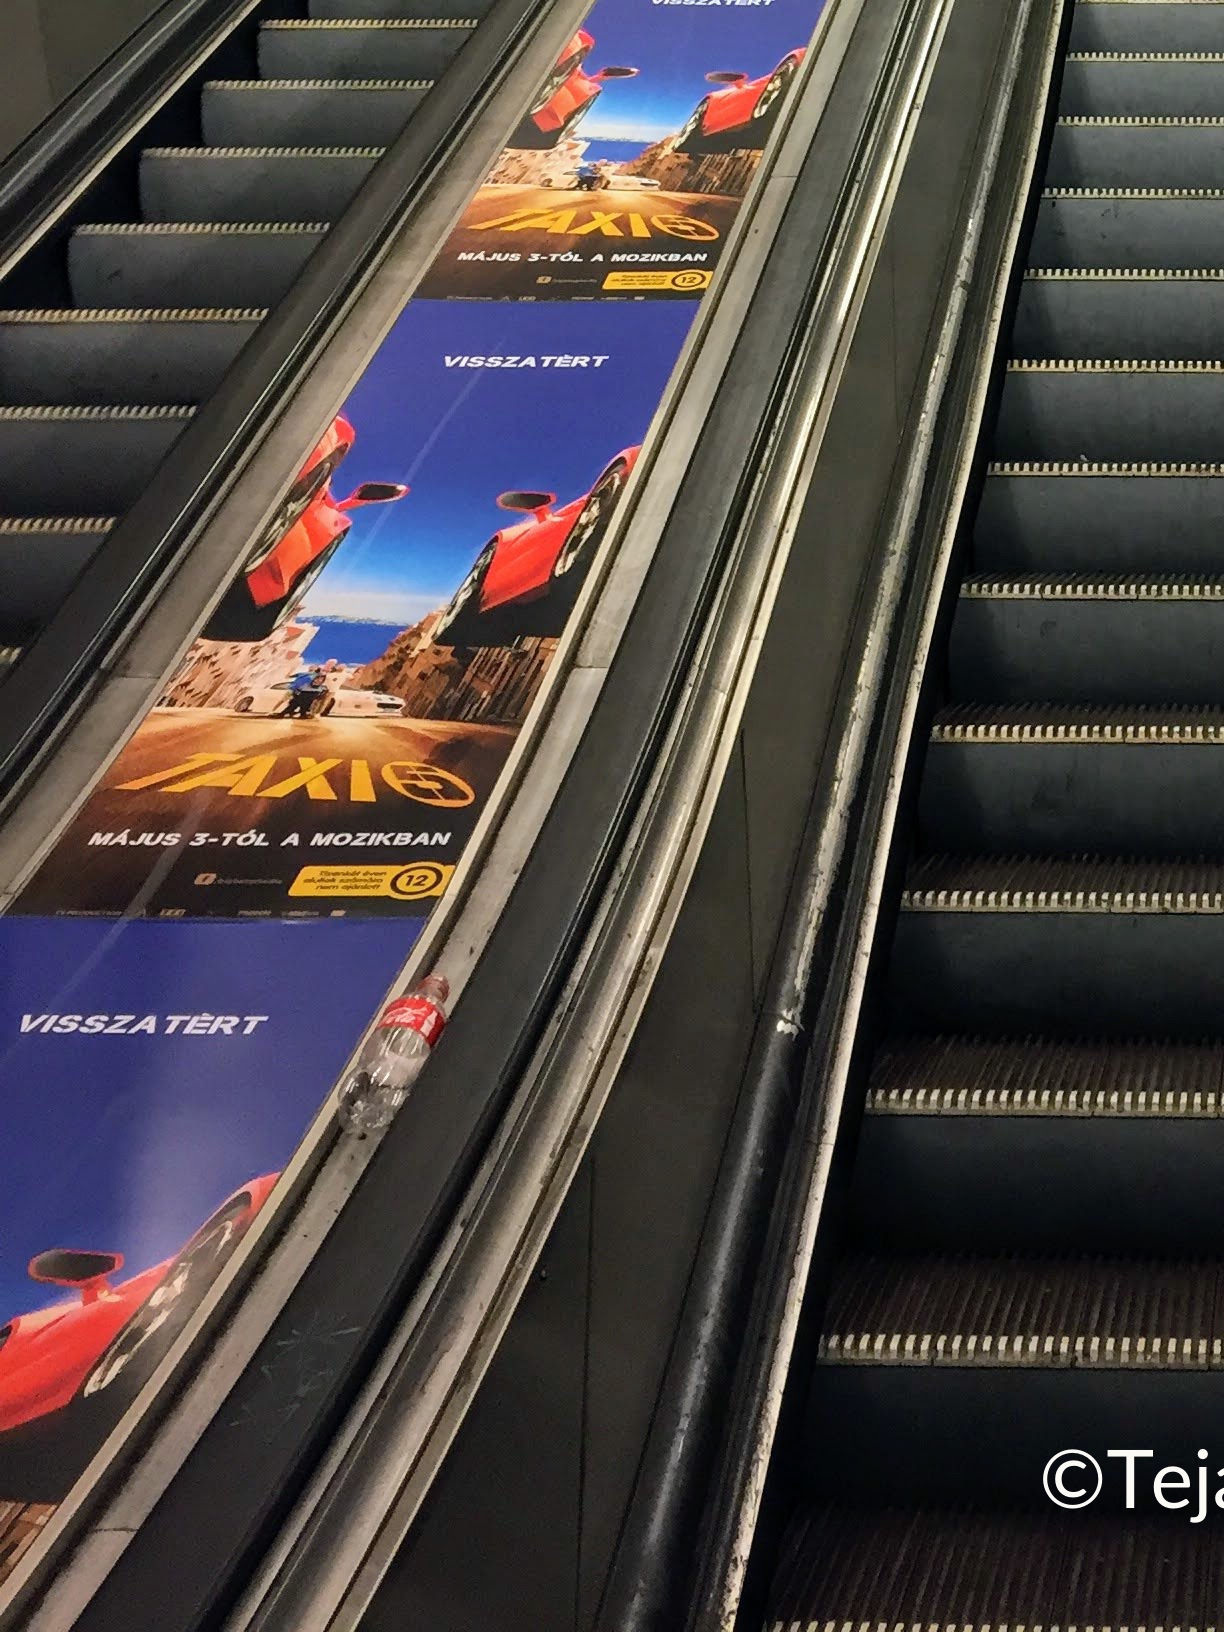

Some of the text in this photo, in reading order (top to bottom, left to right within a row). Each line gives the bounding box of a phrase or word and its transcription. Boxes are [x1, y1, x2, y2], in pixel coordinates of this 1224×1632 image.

[467, 208, 652, 238] TAXI
[457, 250, 708, 262] MÁJUS 3-TÓL A MOZIKBAN
[681, 276, 697, 284] 12
[444, 354, 610, 369] VISSZATÉRT
[114, 752, 377, 803] TAXI
[87, 828, 452, 848] MÁJUS 3-TÓL A MOZIKBAN
[404, 874, 428, 887] 12
[18, 1011, 270, 1036] VISSZATÉRT
